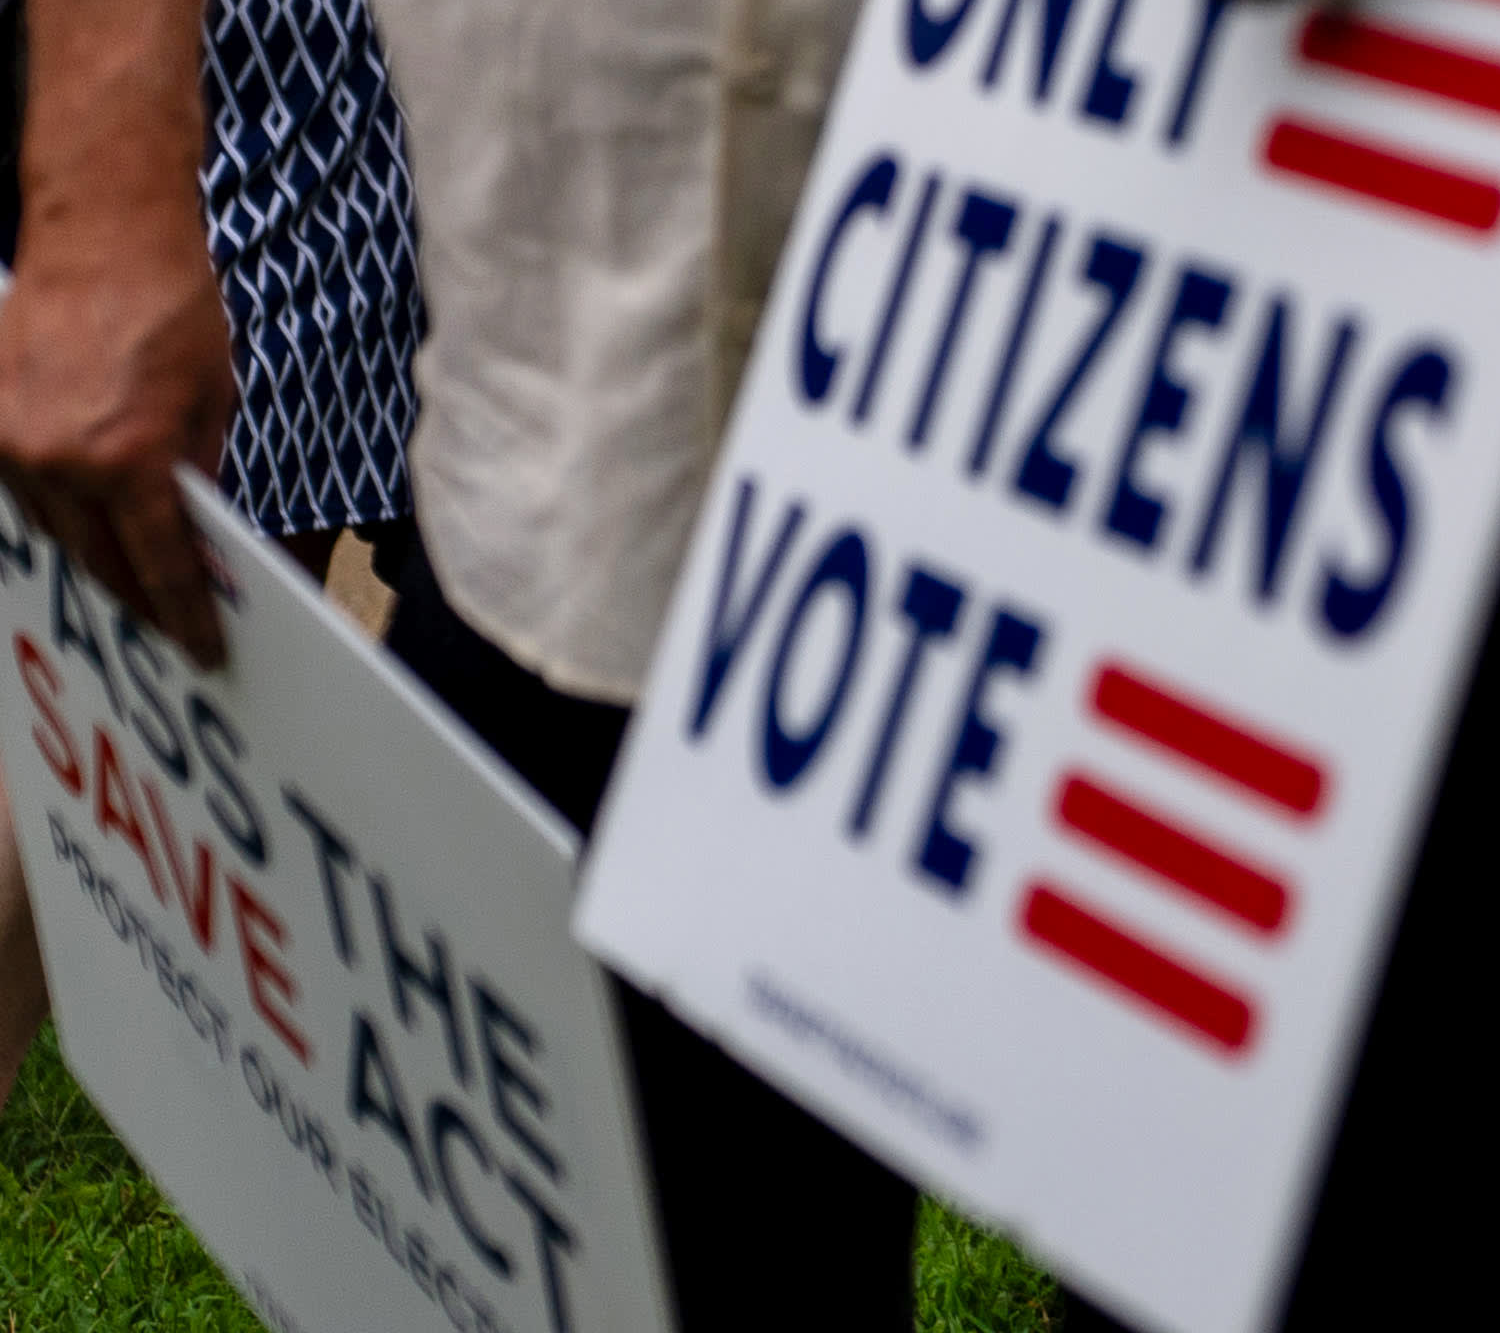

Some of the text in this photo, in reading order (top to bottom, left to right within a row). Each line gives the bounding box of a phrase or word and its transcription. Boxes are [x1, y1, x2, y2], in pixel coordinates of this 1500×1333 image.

[783, 147, 1469, 658] CITIZENS
[680, 467, 1054, 906] VOTE
[13, 630, 582, 1333] SAVE ACT
[45, 808, 234, 1066] PROTECT
[239, 1043, 341, 1195] OUR
[280, 778, 573, 1189] THE
